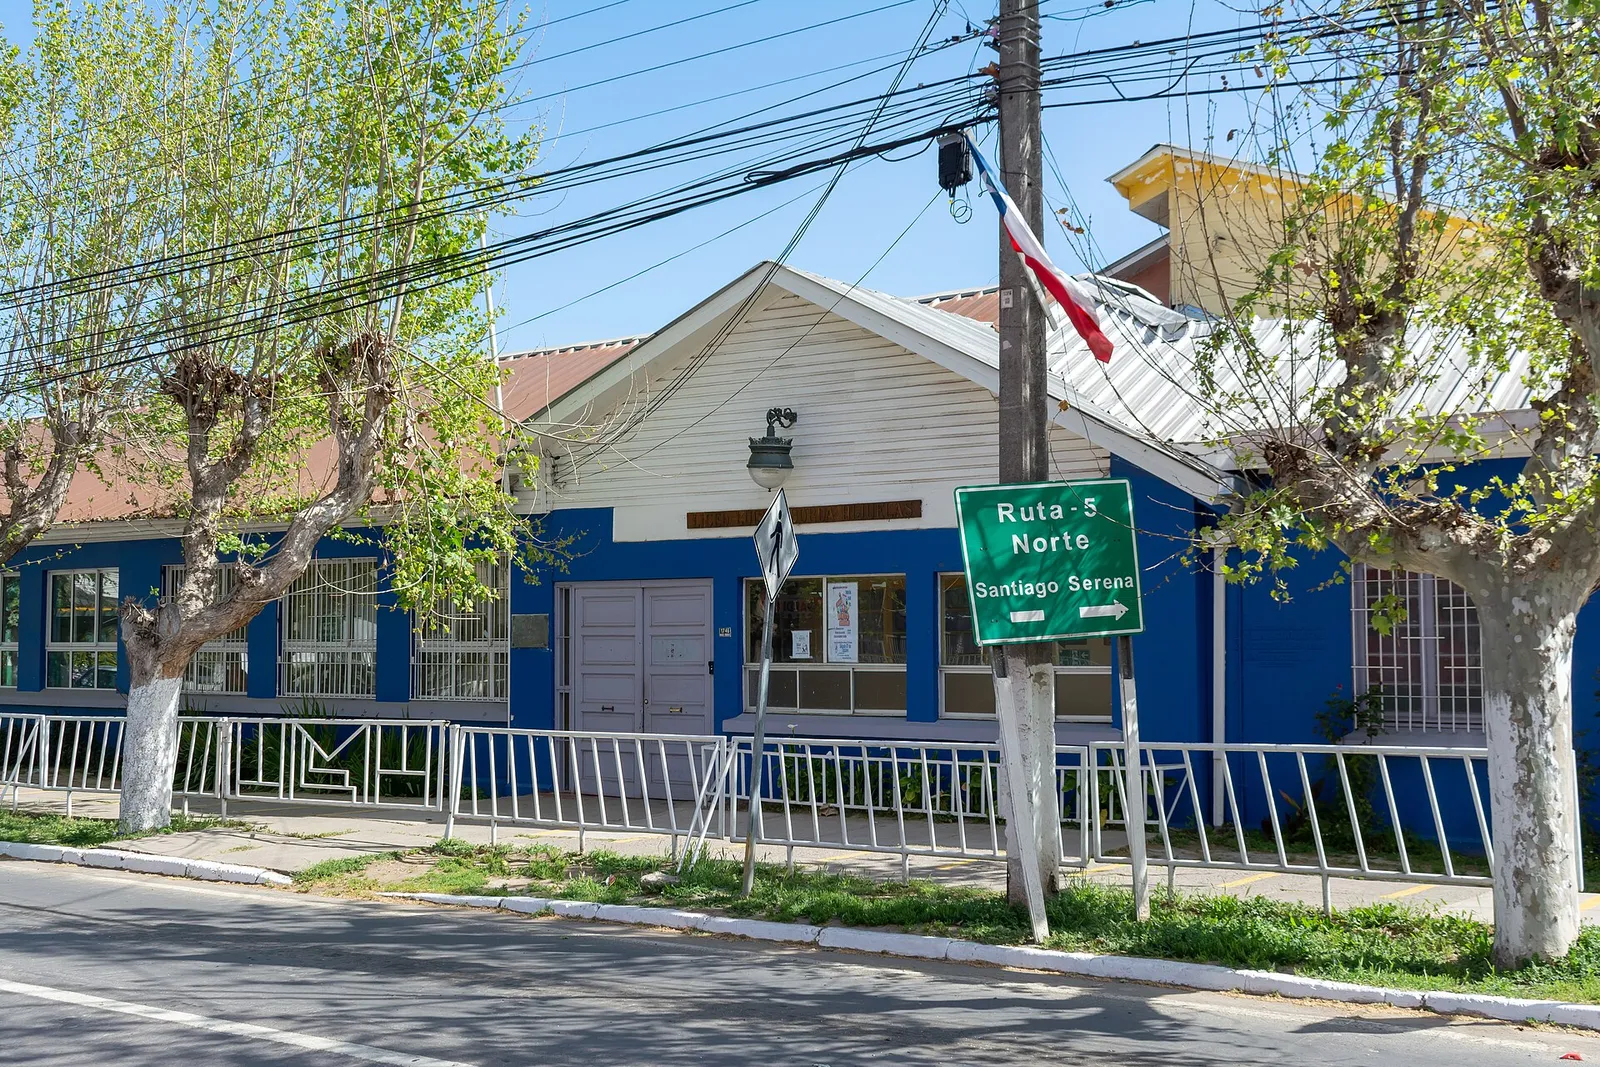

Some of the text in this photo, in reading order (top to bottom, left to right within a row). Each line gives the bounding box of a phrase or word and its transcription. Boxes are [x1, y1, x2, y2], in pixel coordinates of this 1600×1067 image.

[1011, 531, 1090, 554] Norte
[975, 575, 1134, 598] Santiago Serena
